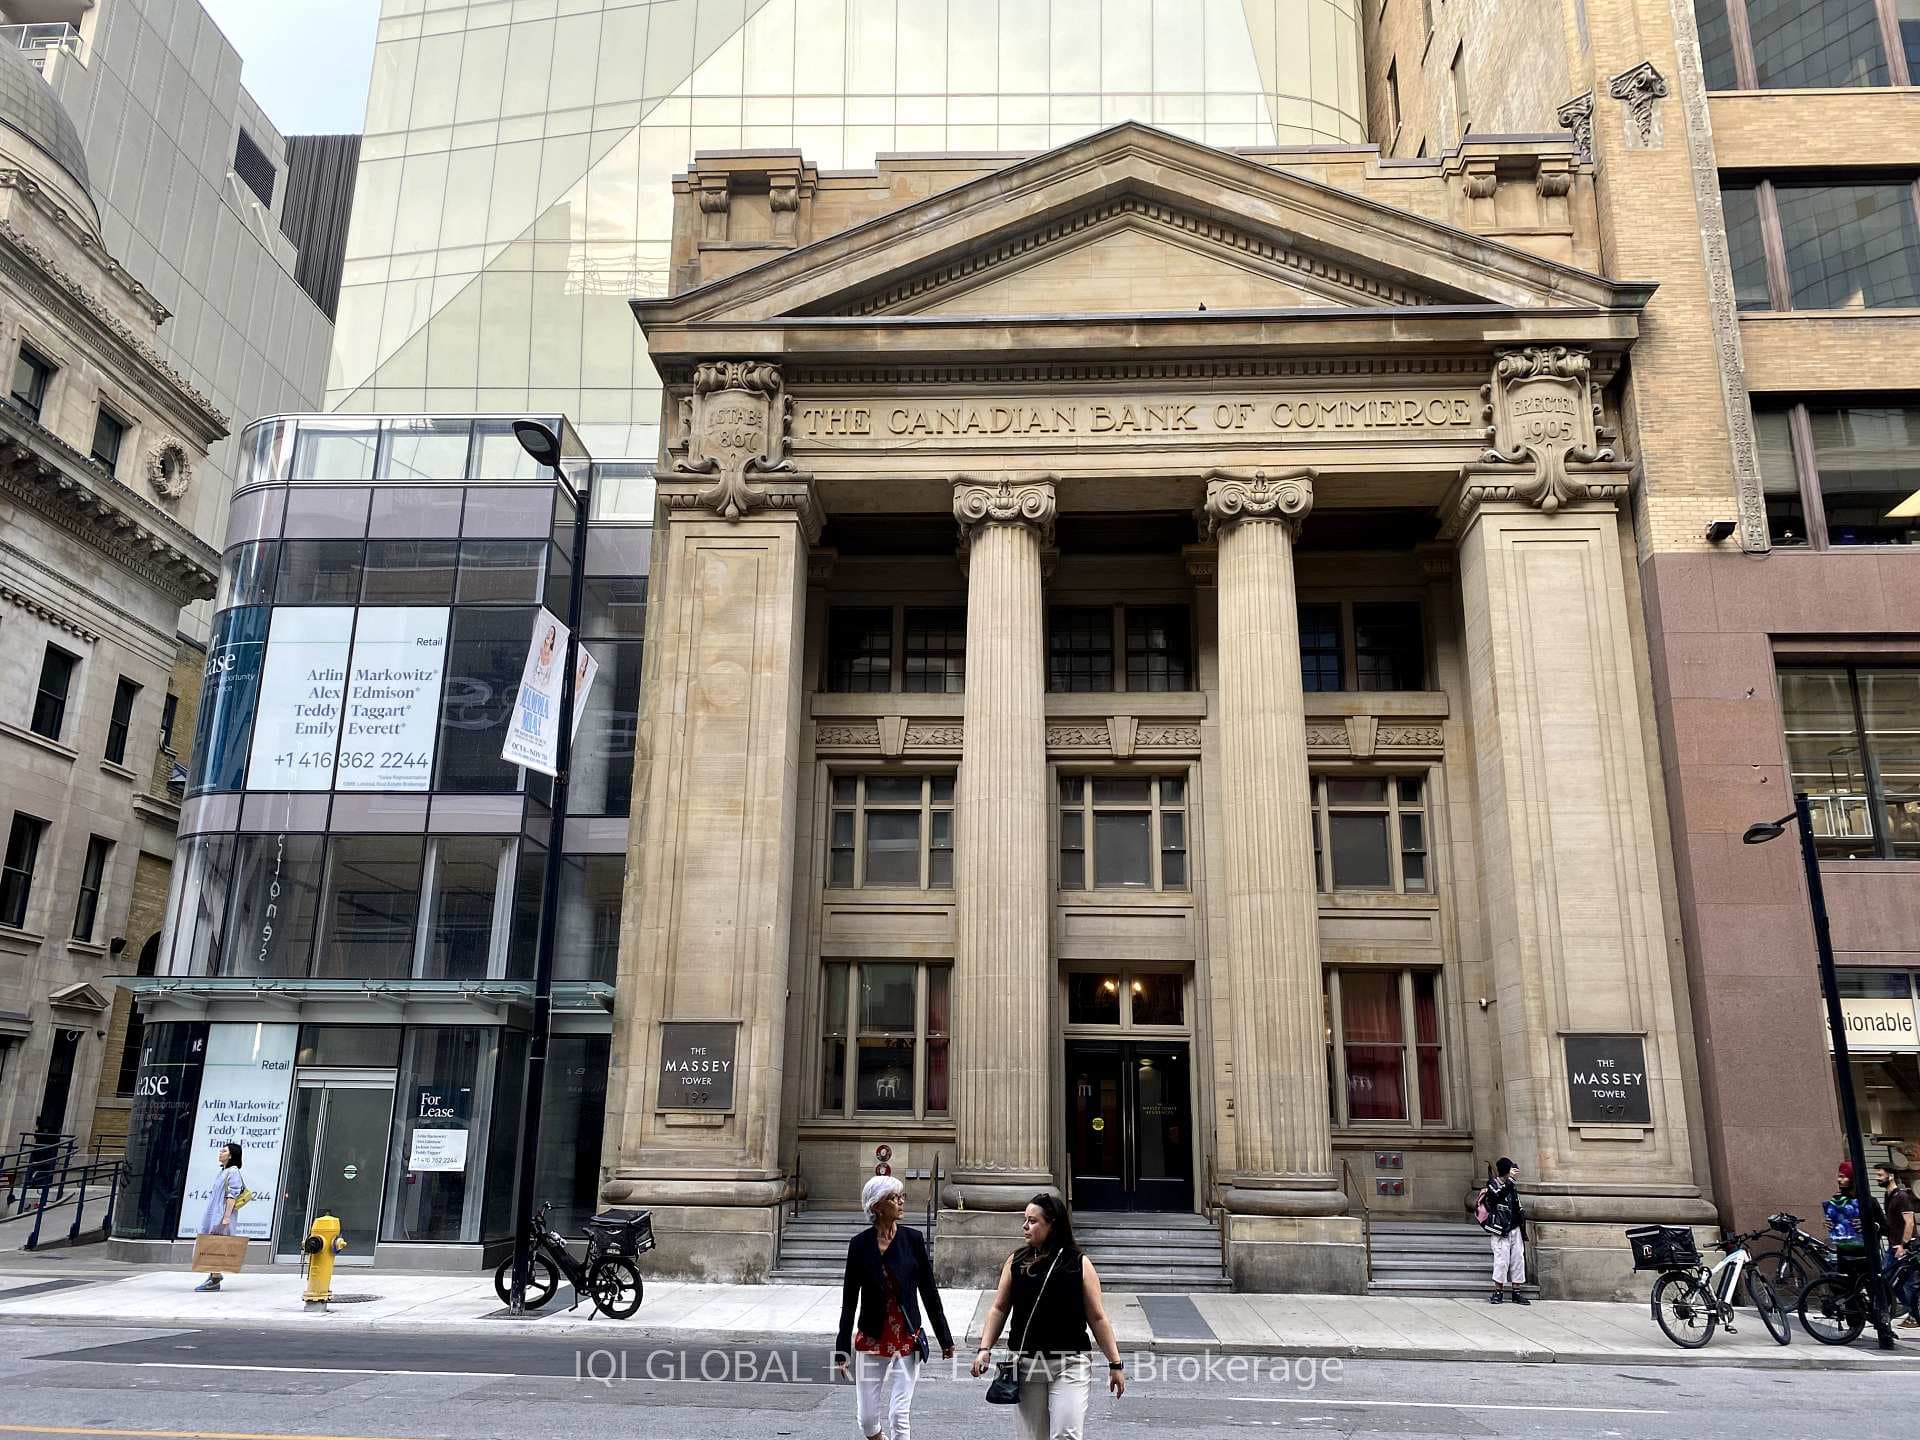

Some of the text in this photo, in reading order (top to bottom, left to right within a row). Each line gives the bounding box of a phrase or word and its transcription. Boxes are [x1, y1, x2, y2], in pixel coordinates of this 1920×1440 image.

[803, 399, 1472, 436] THE CANADIAN BANK OF COMMERCE
[416, 636, 443, 647] Retail
[307, 668, 344, 681] Arlin
[308, 686, 341, 699] Alex
[294, 703, 339, 719] Teddy
[294, 721, 337, 738] Emily
[274, 752, 429, 769] +1 416 362 2244
[690, 1047, 707, 1056] THE
[261, 1059, 290, 1071] Retail
[664, 1060, 731, 1073] MASSEY
[1596, 1059, 1616, 1068] THE
[681, 1077, 713, 1086] TOWER
[1573, 1072, 1643, 1086] MASSEY
[421, 1092, 442, 1106] For
[1591, 1089, 1627, 1099] TOWER
[202, 1099, 226, 1110] Arlin
[212, 1112, 235, 1122] Alex
[419, 1105, 455, 1118] Lease
[207, 1125, 237, 1137] Teddy
[187, 1190, 200, 1201] +1
[251, 1190, 272, 1202] 244
